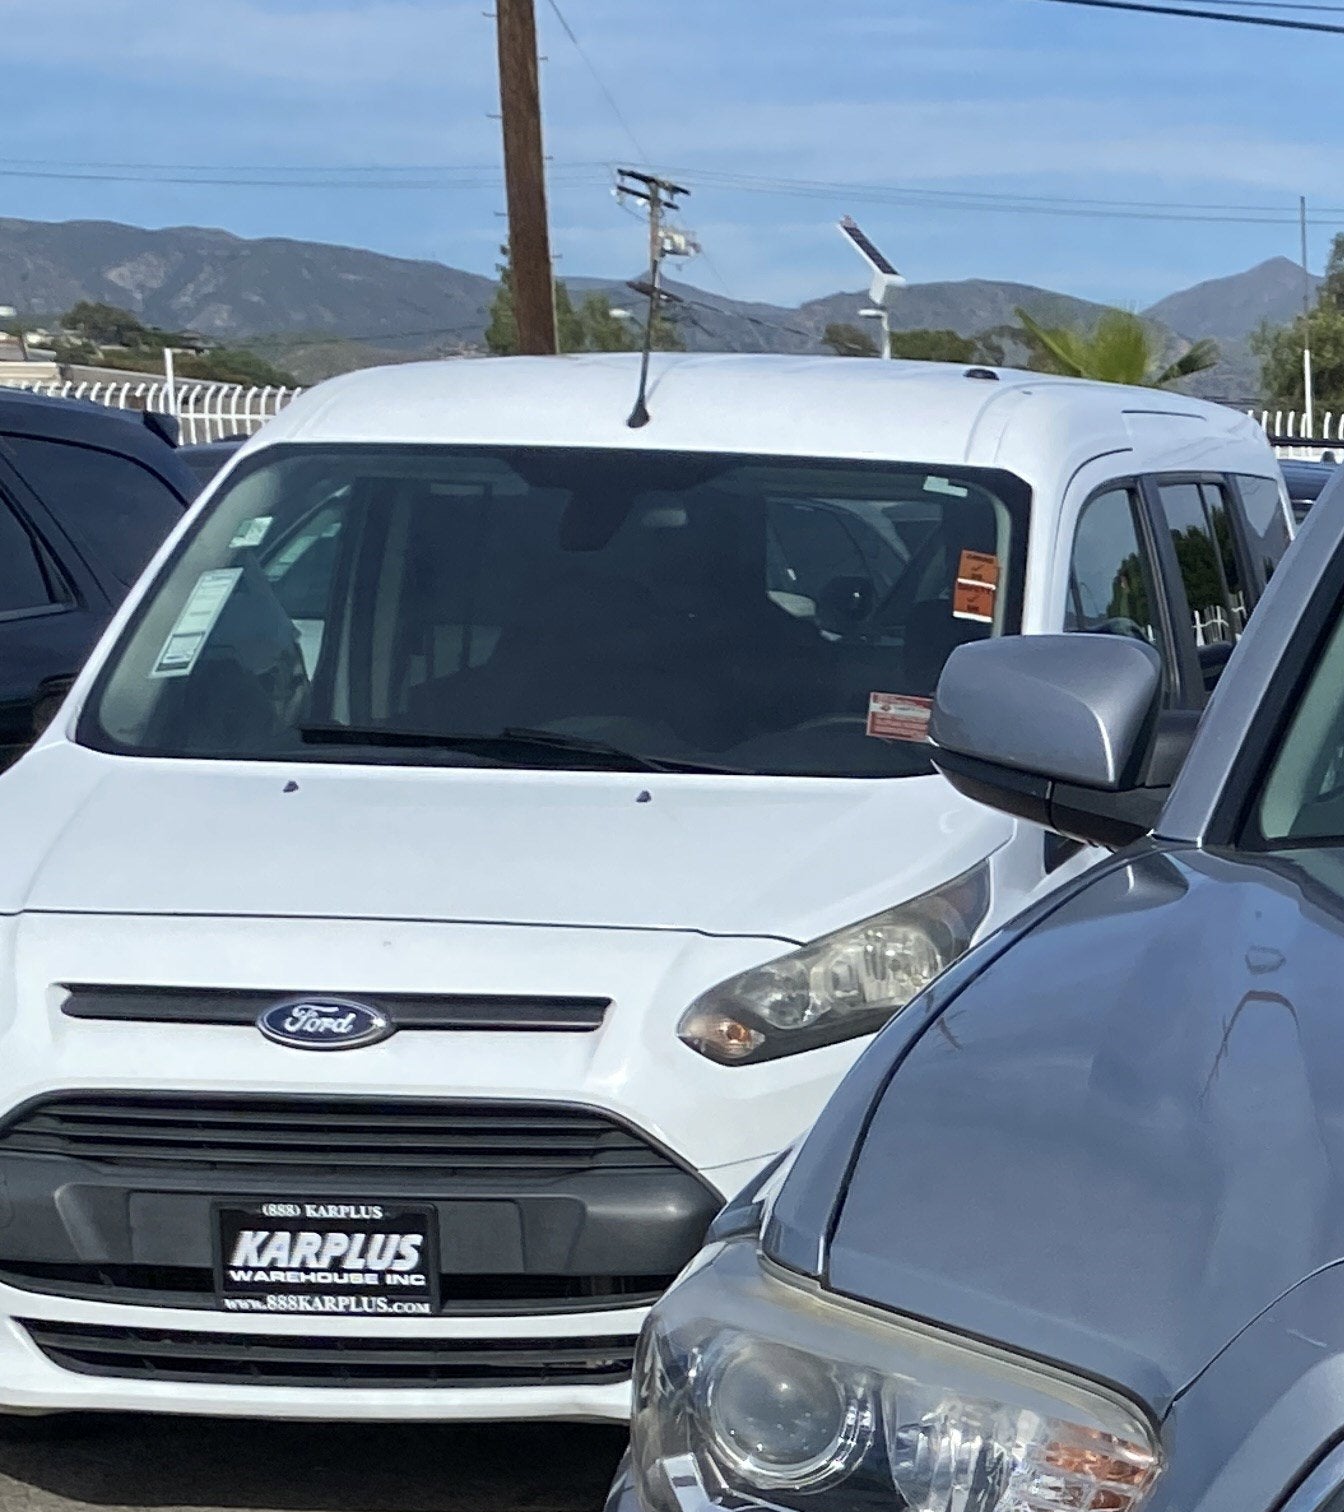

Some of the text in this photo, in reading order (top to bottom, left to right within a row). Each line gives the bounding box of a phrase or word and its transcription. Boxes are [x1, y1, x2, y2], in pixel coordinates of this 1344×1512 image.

[284, 1004, 357, 1034] Ford
[262, 1204, 383, 1219] (888) KARPLUS
[229, 1230, 424, 1271] KARPLUS
[229, 1270, 426, 1286] WAREHOUSE INC
